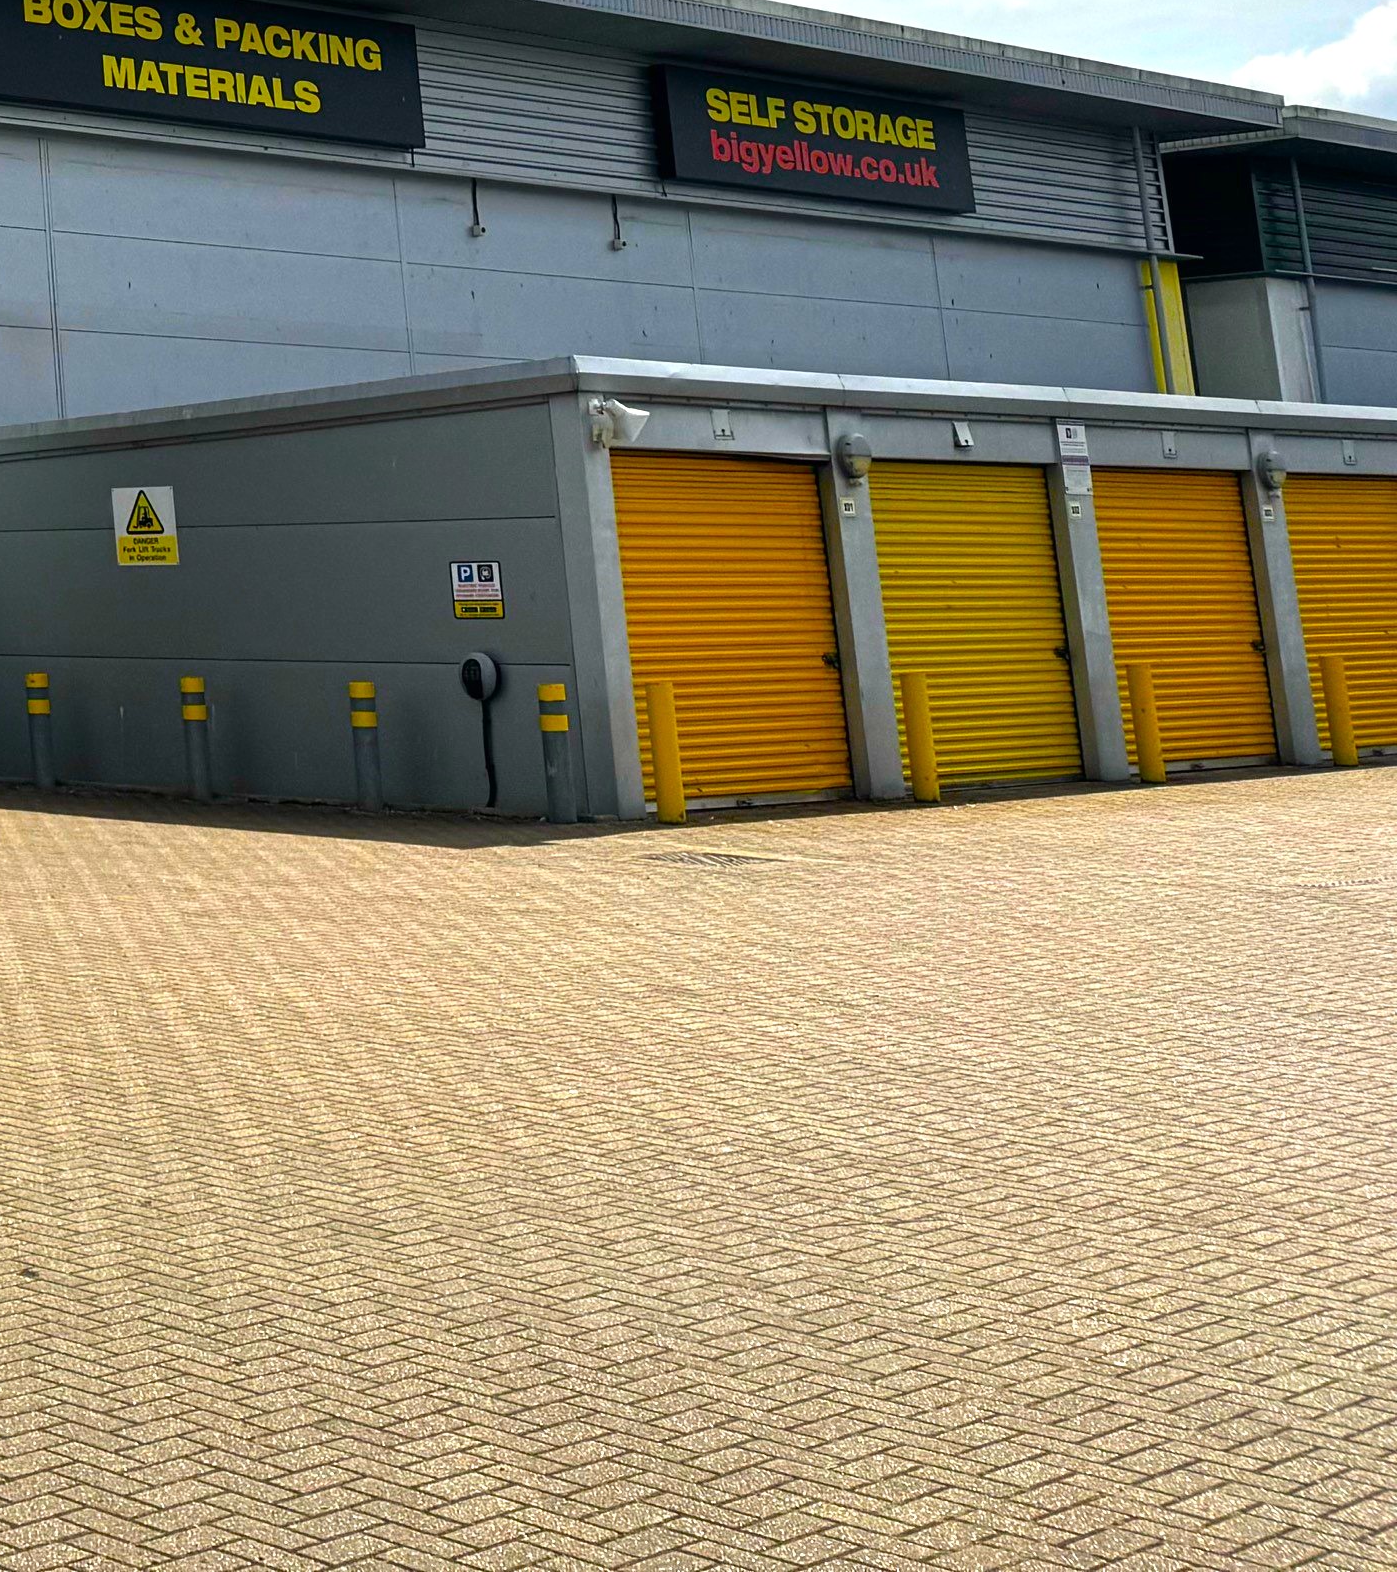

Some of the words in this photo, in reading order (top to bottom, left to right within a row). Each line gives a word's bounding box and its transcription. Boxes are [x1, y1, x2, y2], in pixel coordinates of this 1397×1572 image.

[174, 13, 204, 47] &
[215, 18, 383, 71] PACKING
[102, 54, 322, 115] MATERIALS
[705, 88, 786, 128] SELF
[793, 101, 937, 151] STORAGE
[710, 129, 940, 188] bigyellow.co.uk
[133, 537, 159, 545] DANGER
[136, 554, 167, 562] Operation
[460, 566, 471, 581] P
